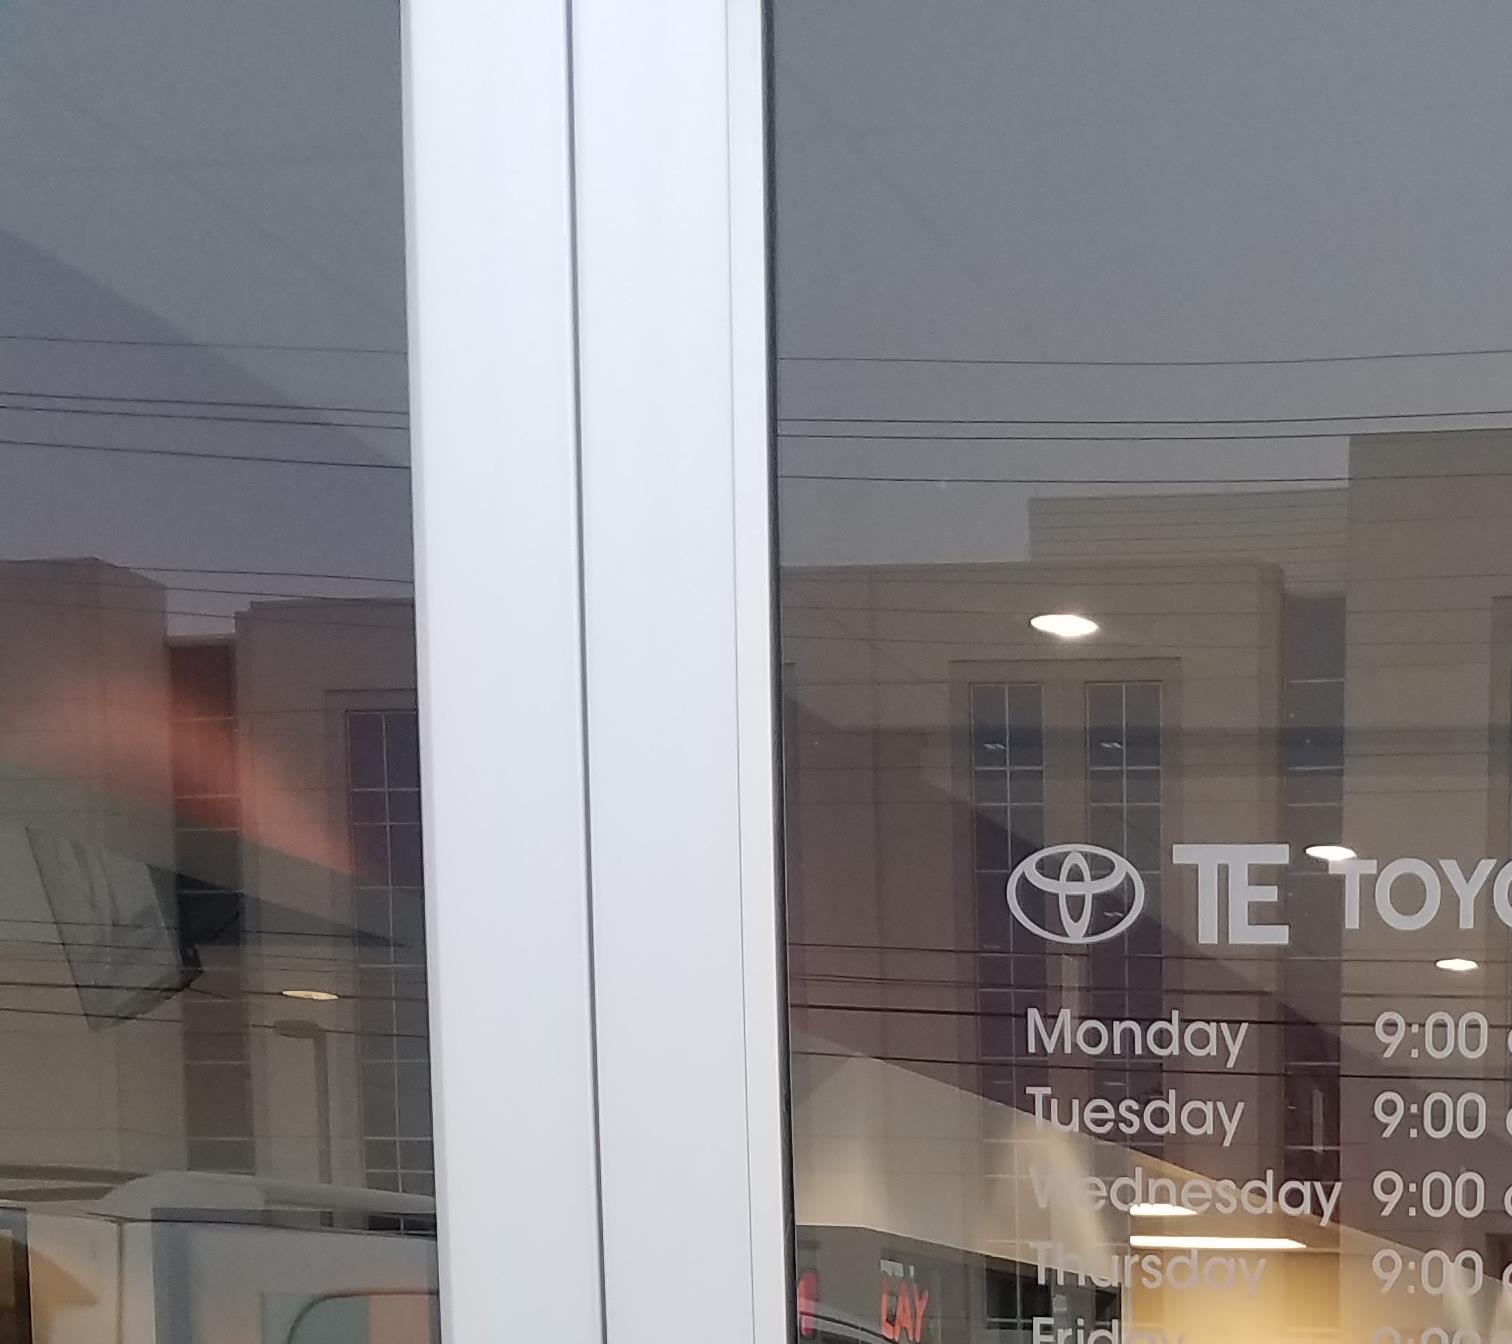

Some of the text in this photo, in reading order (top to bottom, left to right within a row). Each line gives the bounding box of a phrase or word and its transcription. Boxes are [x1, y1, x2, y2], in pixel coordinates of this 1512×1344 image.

[1027, 1008, 1249, 1069] Monday
[1374, 1010, 1488, 1061] 9:00
[1027, 1087, 1246, 1149] Tuesday
[1373, 1092, 1488, 1142] 9:00
[1028, 1165, 1342, 1229] Wednesday
[1372, 1171, 1487, 1221] 9:00
[1029, 1241, 1267, 1298] Thursday
[1371, 1250, 1485, 1301] 9:00
[880, 1277, 929, 1343] LAY
